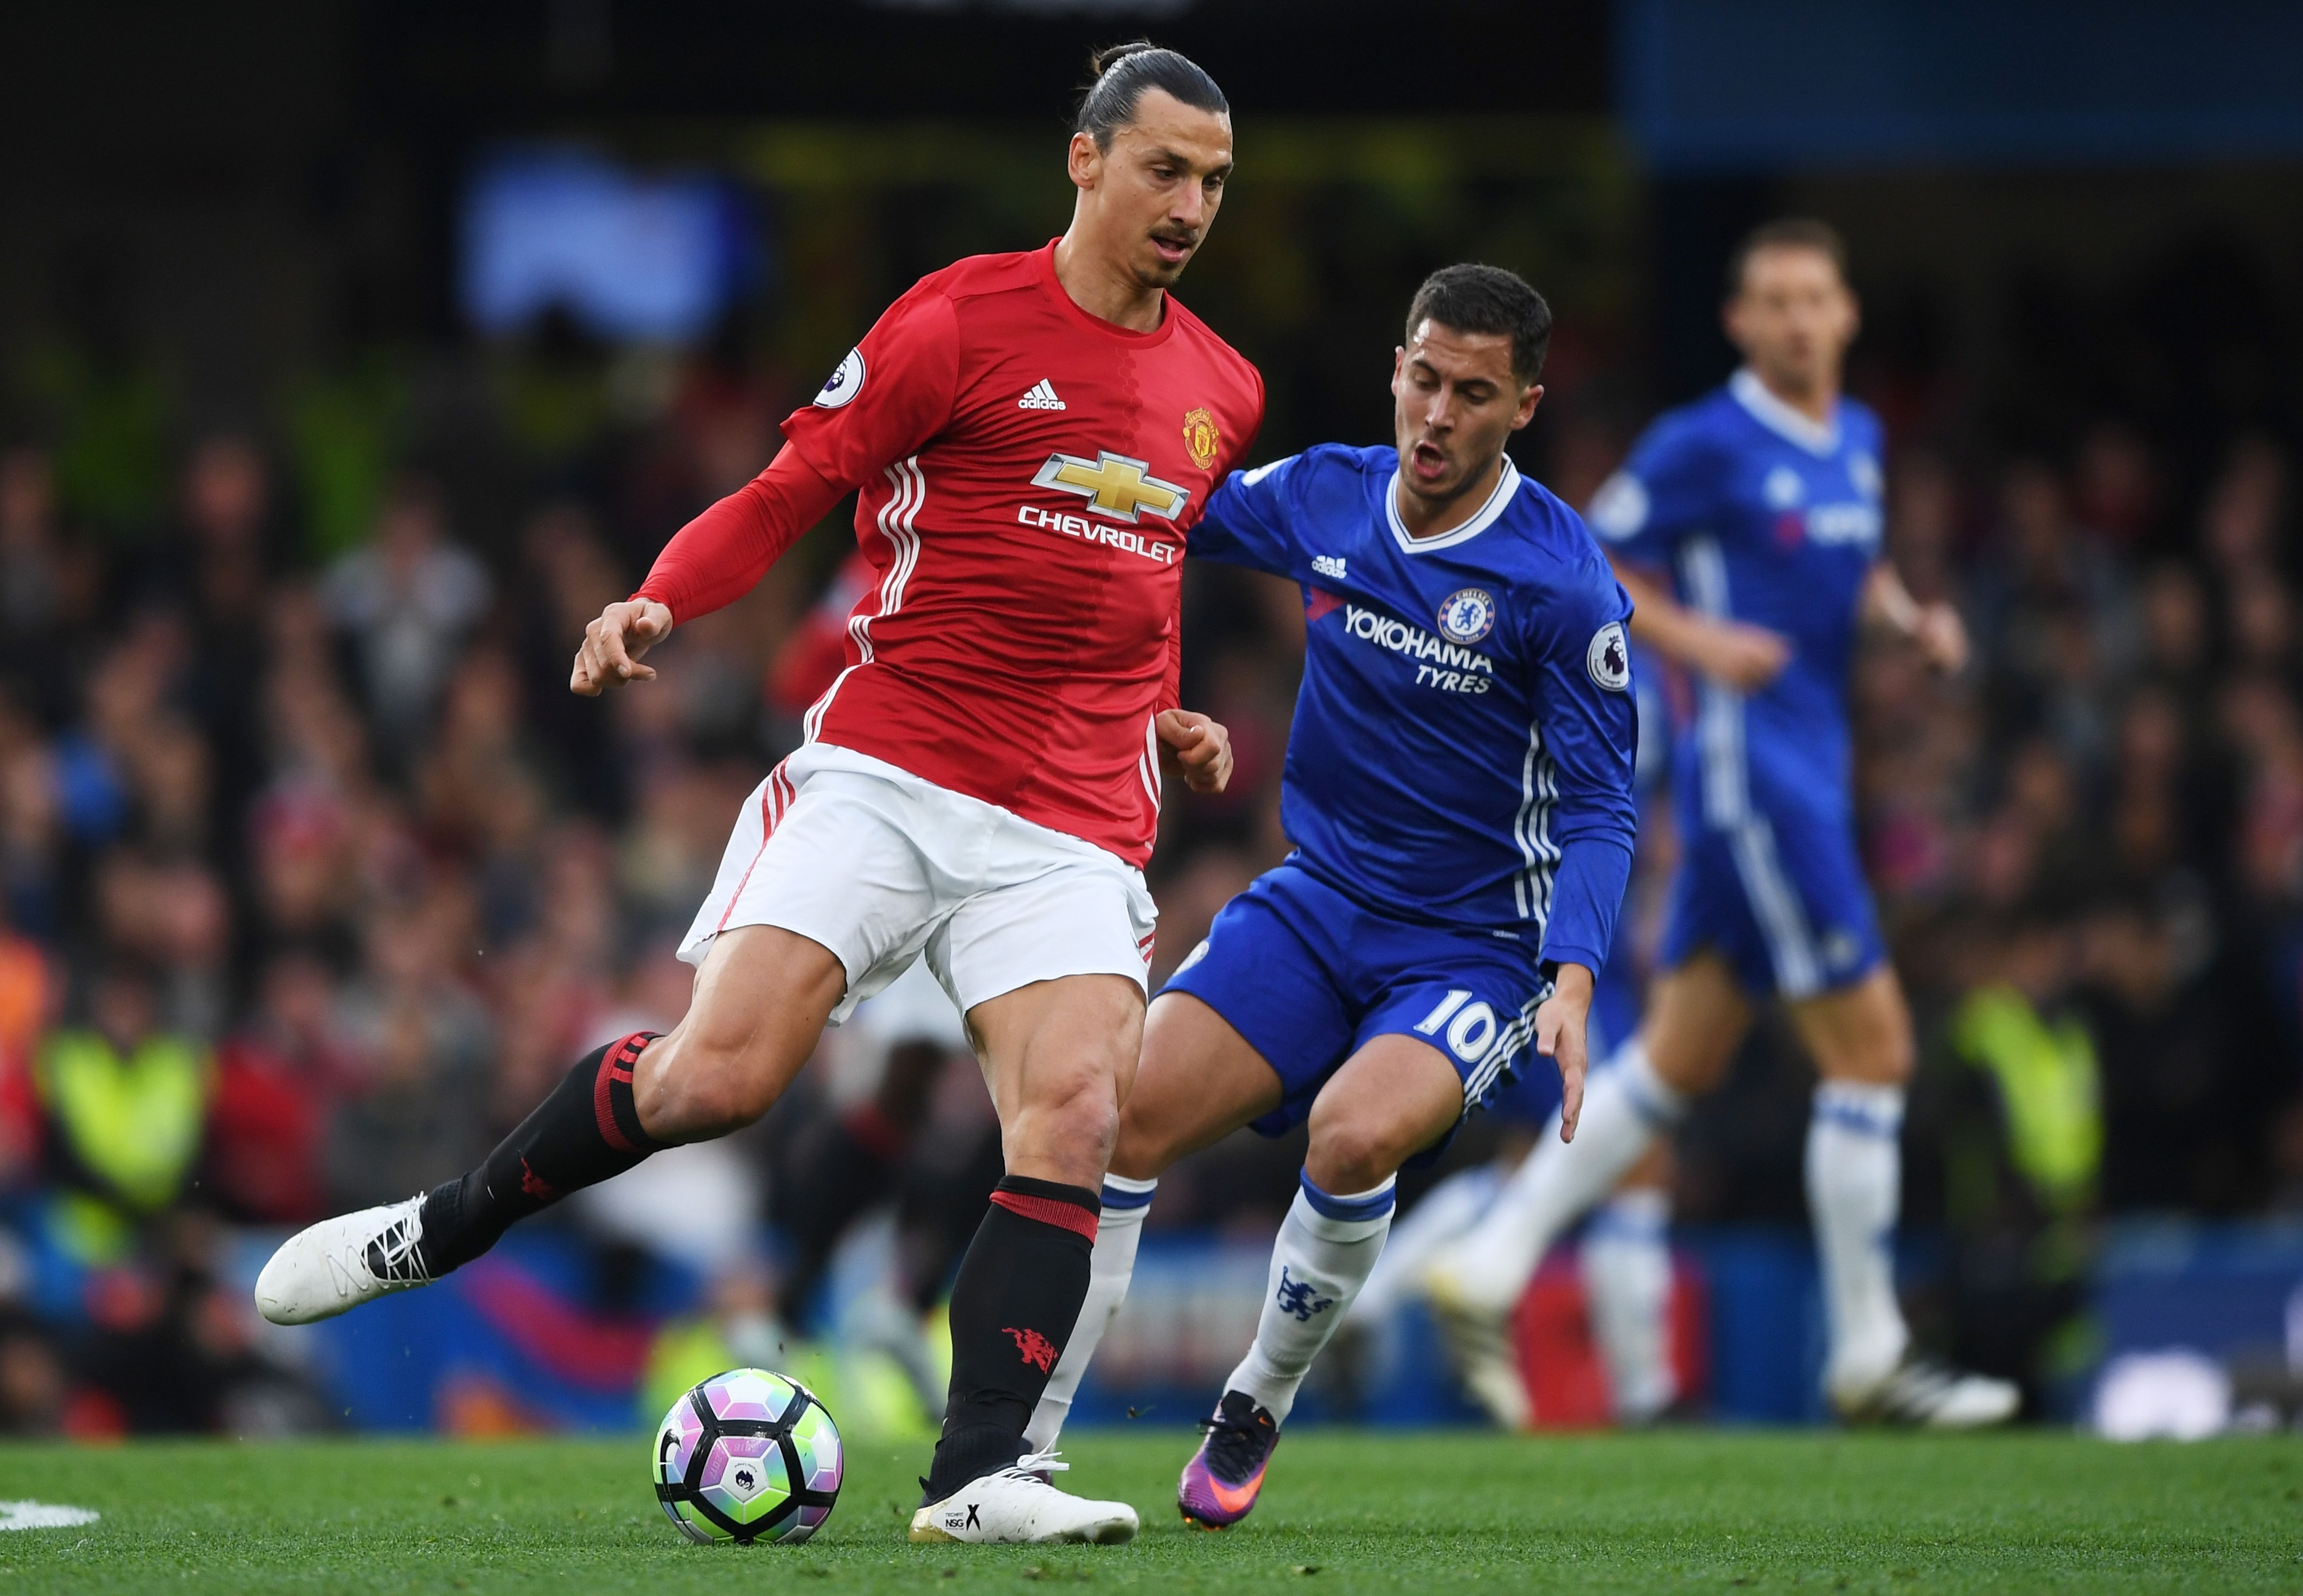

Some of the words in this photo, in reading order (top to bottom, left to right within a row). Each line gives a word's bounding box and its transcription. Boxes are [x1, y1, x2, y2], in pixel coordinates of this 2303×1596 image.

[1018, 397, 1066, 410] adidas
[1190, 449, 1210, 467] UNITED
[1018, 506, 1175, 564] CHEVROLET
[1456, 590, 1489, 607] CHELSEA
[1345, 603, 1493, 674] YOKOHAMA
[1415, 664, 1492, 694] TYRES
[1413, 989, 1496, 1063] 10
[945, 1519, 964, 1528] NSG
